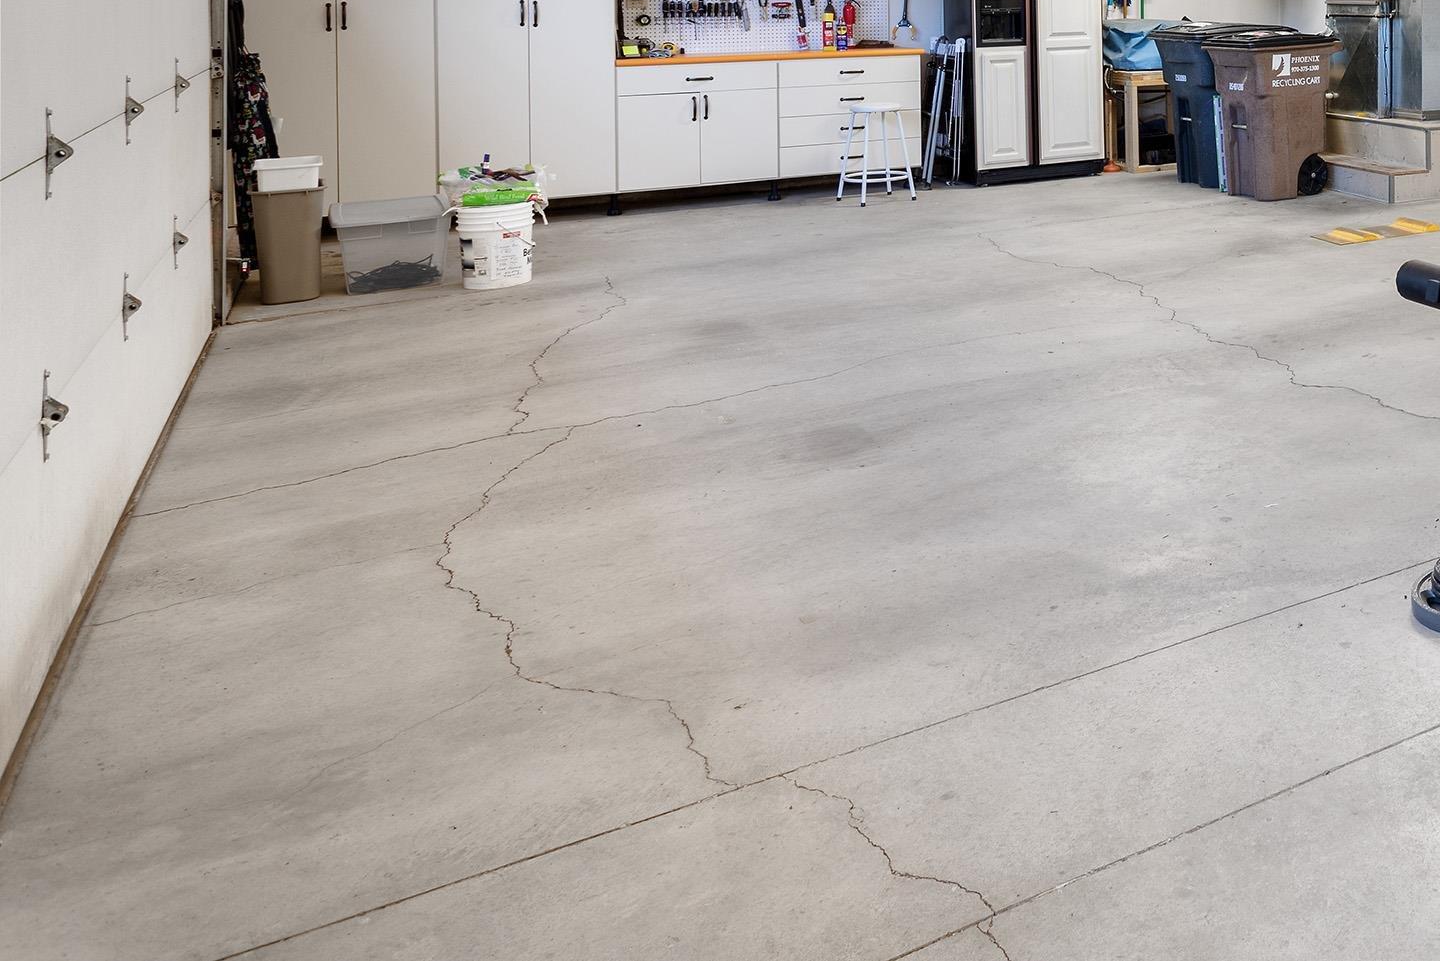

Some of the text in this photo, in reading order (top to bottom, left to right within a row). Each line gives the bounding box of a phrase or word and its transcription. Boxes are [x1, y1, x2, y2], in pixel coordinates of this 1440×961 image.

[1291, 55, 1320, 63] PHOENIX
[1271, 76, 1320, 88] RECYCLING CART
